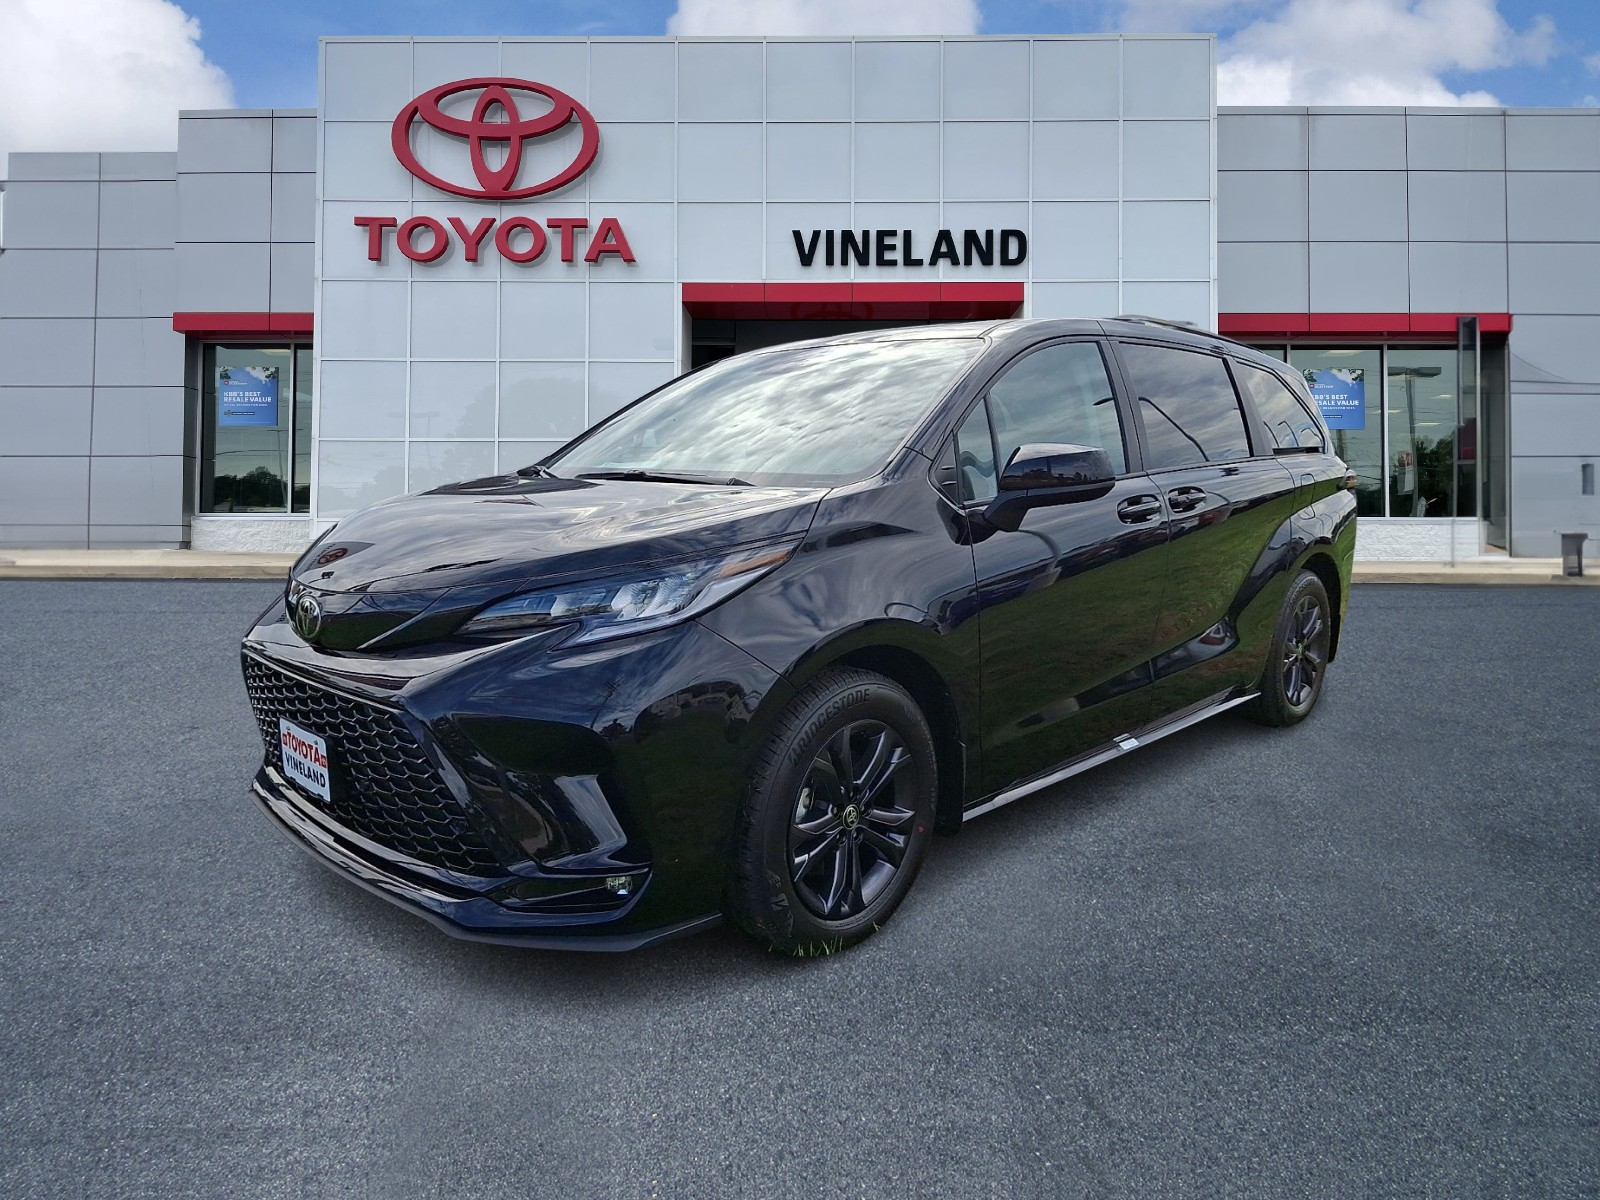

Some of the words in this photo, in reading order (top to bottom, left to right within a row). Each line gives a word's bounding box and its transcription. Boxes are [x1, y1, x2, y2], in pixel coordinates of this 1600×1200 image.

[354, 216, 636, 263] TOYOTA
[792, 229, 1028, 267] VINELAND
[286, 731, 322, 766] TOYOTA
[285, 751, 325, 788] VINELAND
